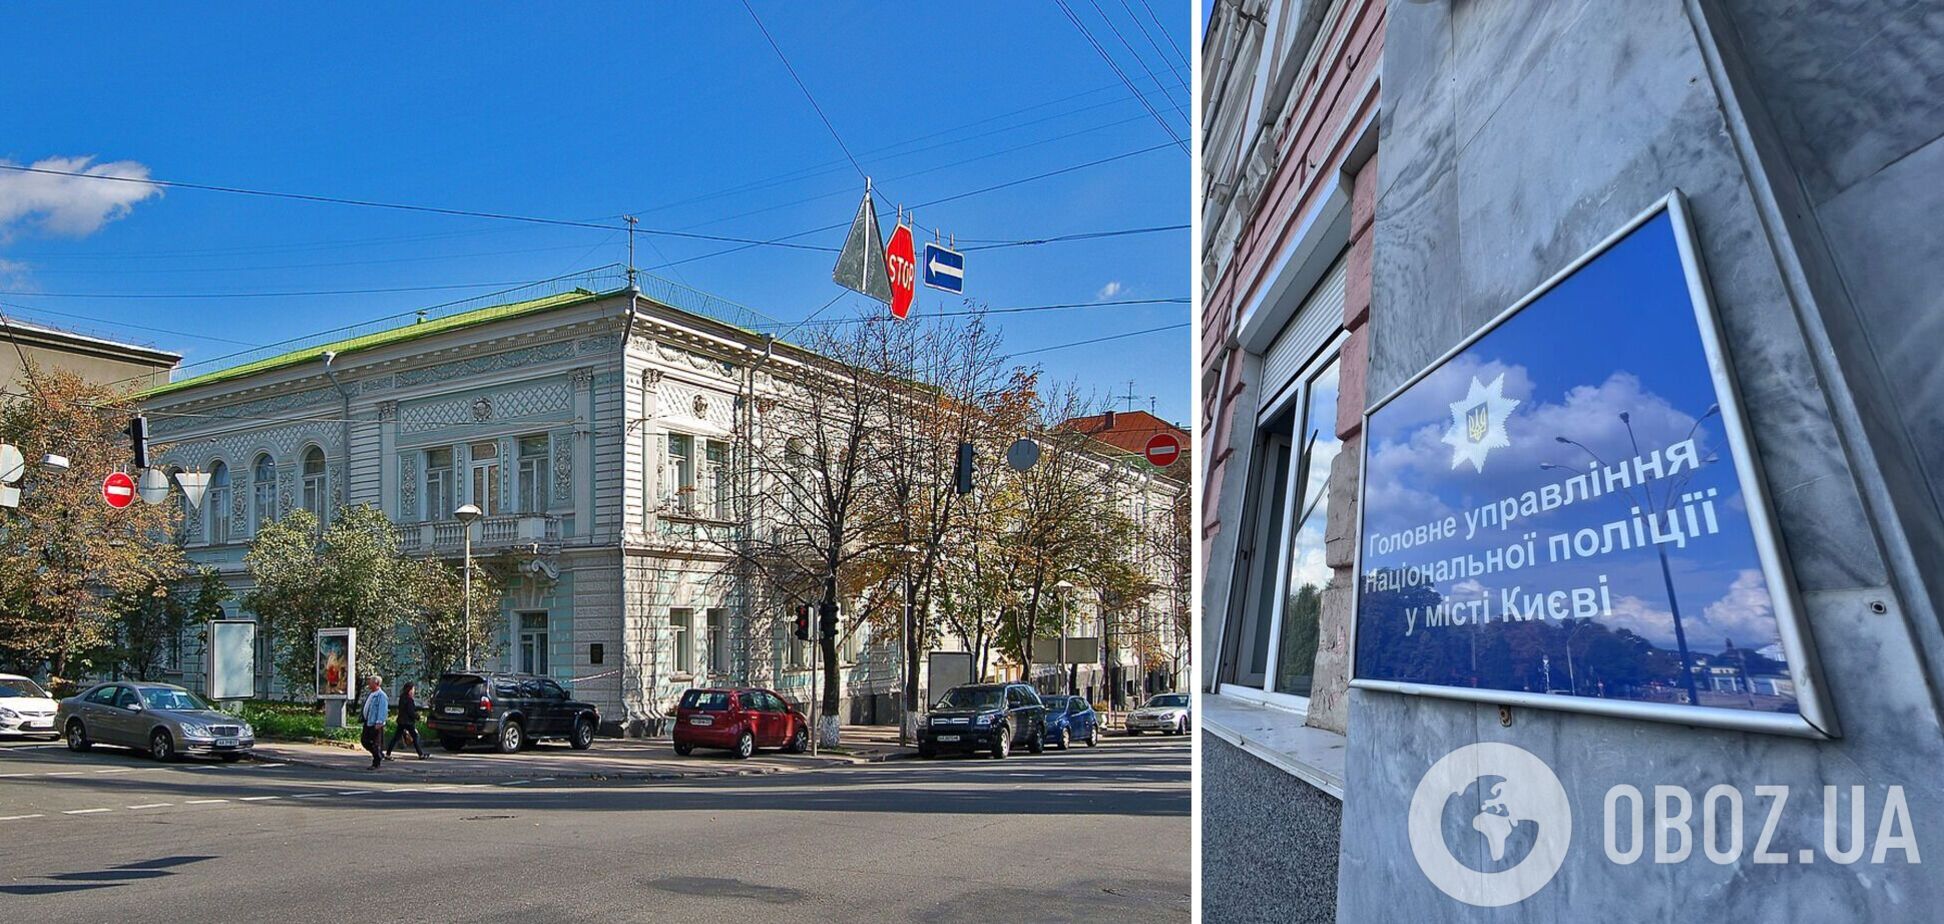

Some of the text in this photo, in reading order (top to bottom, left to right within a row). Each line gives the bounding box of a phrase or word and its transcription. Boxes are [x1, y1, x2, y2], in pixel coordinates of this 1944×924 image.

[889, 254, 914, 290] STOP
[1369, 438, 1700, 557] Головне управління
[1364, 488, 1719, 594] Національної поліції
[1405, 575, 1611, 636] у місті Києві
